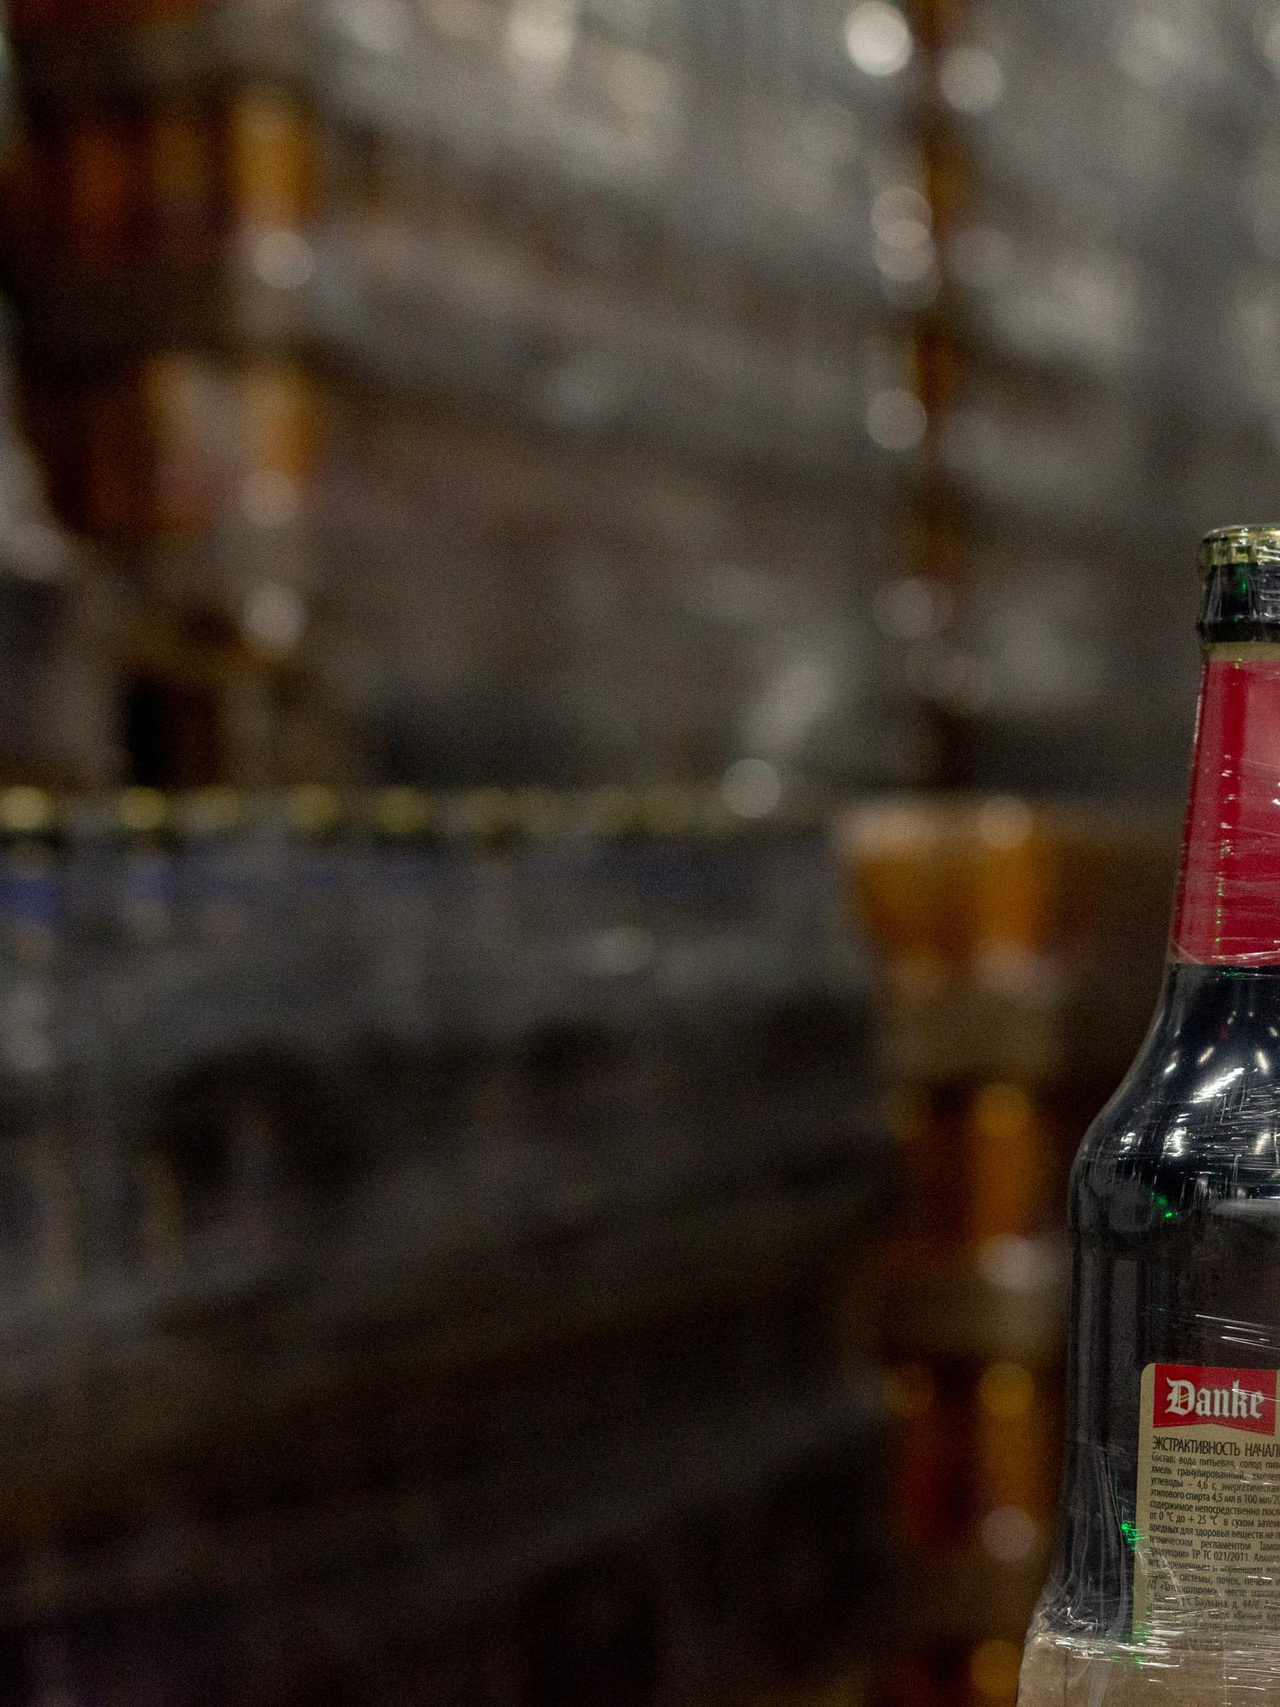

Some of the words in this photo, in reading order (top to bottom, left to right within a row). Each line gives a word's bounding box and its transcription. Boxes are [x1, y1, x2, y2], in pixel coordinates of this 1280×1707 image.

[1165, 1376, 1264, 1419] Danke
[1152, 1436, 1241, 1456] ЭКСТРАКТИВНОСТЬ
[1178, 1457, 1197, 1466] вода
[1239, 1460, 1262, 1470] солод
[1185, 1491, 1210, 1502] спирта
[1195, 1503, 1260, 1516] непосредственно
[1197, 1514, 1207, 1525] 25
